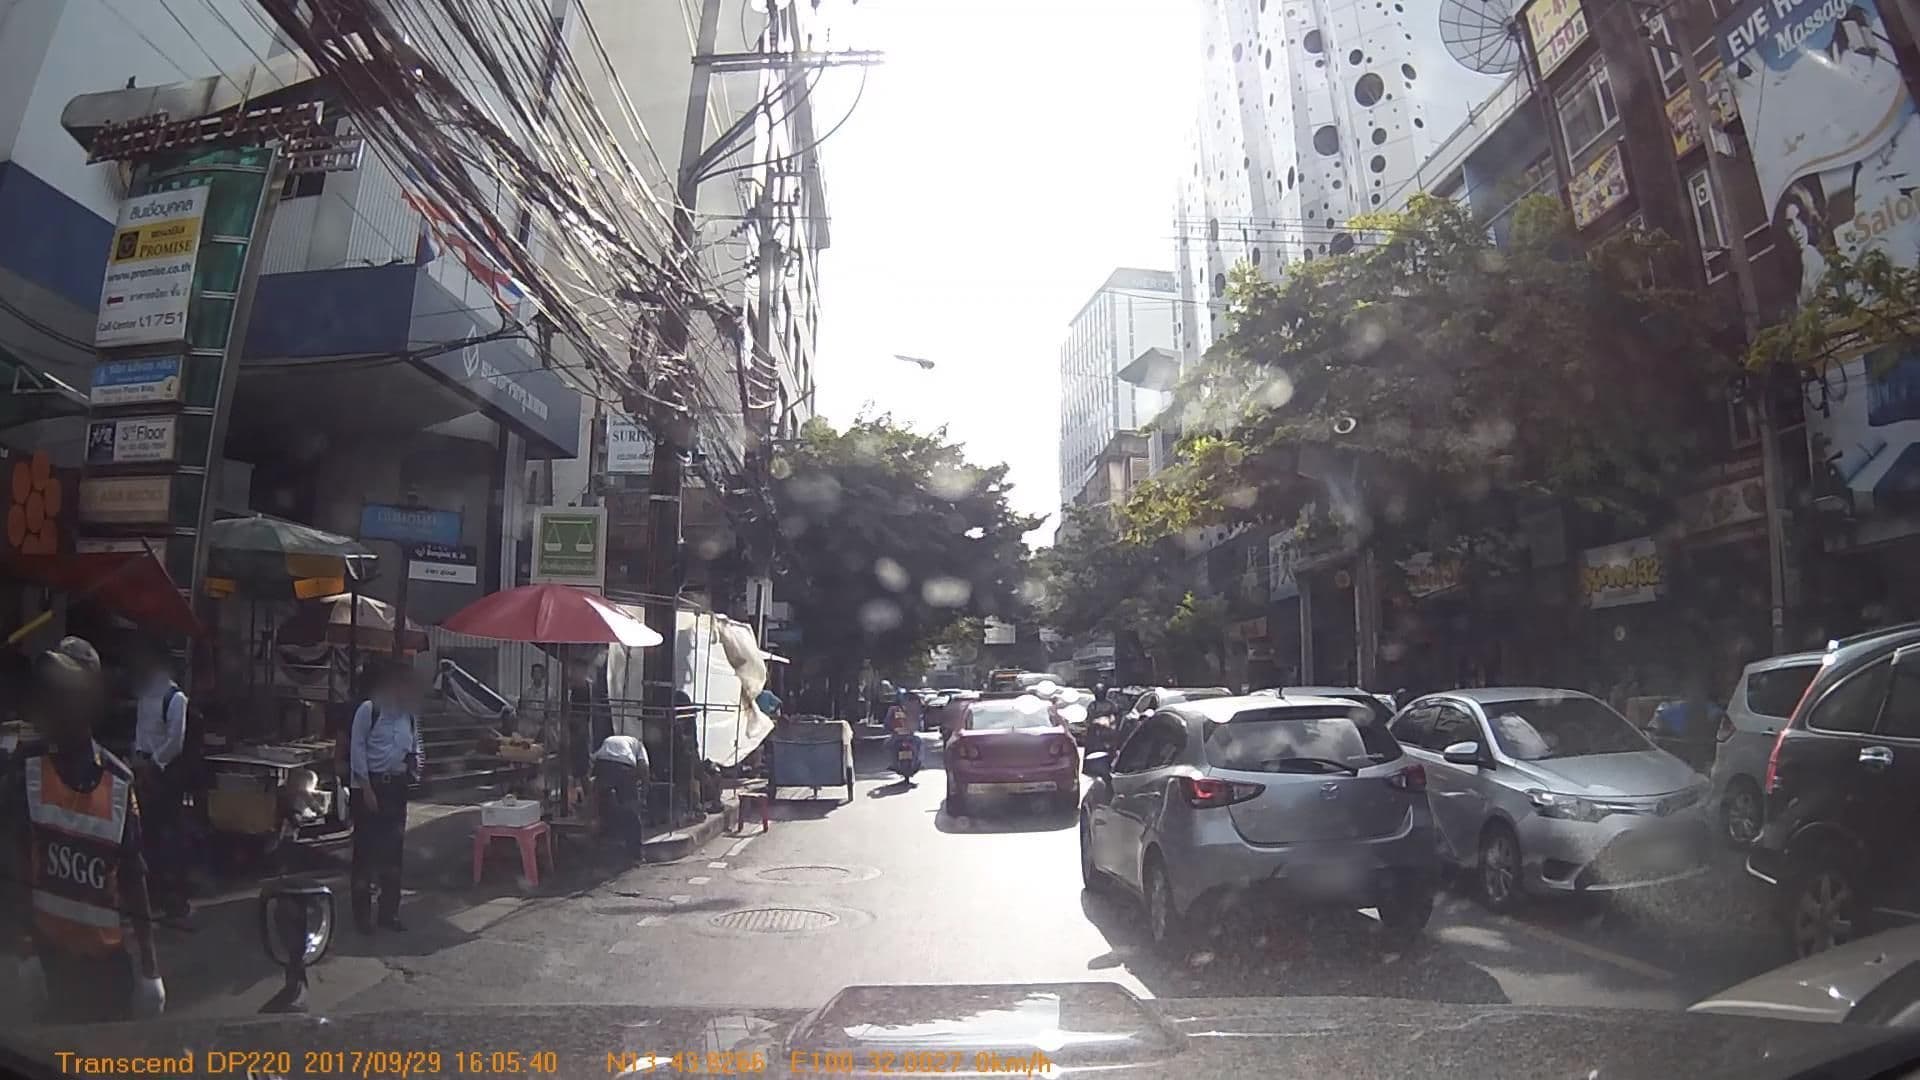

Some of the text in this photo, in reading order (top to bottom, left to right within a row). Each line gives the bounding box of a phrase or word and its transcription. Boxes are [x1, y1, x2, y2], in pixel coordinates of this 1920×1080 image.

[1727, 6, 1770, 57] EVE
[139, 239, 193, 258] PROMISE
[107, 263, 192, 282] www.promise.co.th
[99, 311, 184, 331] Call Center 1751
[137, 425, 166, 440] Floor
[47, 842, 105, 889] SSGG
